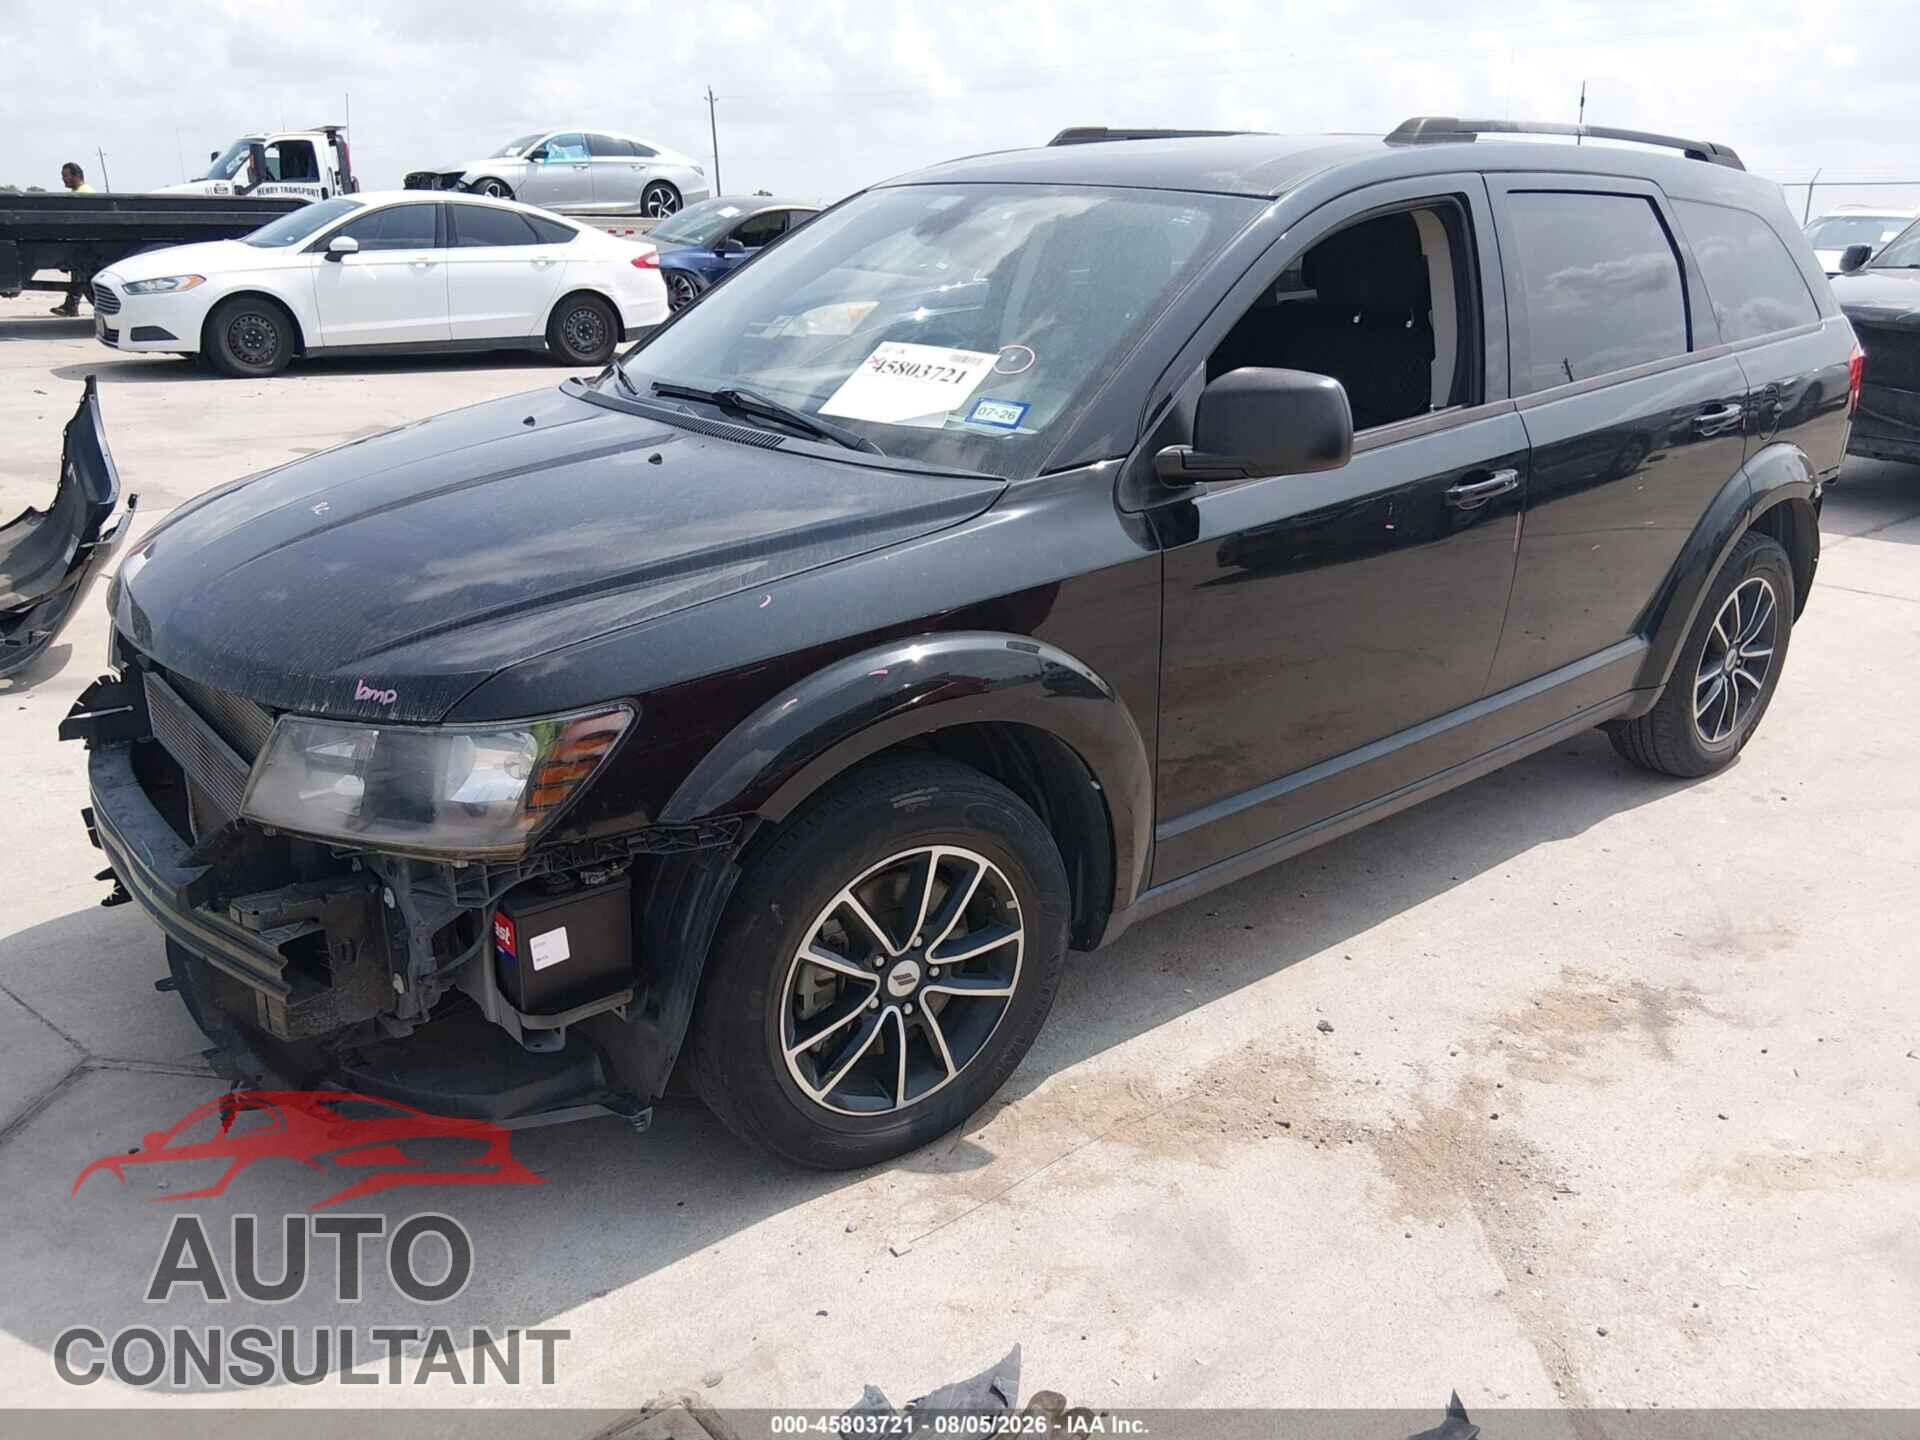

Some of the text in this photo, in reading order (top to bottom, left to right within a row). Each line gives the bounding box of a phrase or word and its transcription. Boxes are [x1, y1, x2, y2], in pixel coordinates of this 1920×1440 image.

[280, 186, 320, 198] TRANSPORT
[872, 359, 968, 384] 45803721
[977, 406, 1016, 421] 07-26
